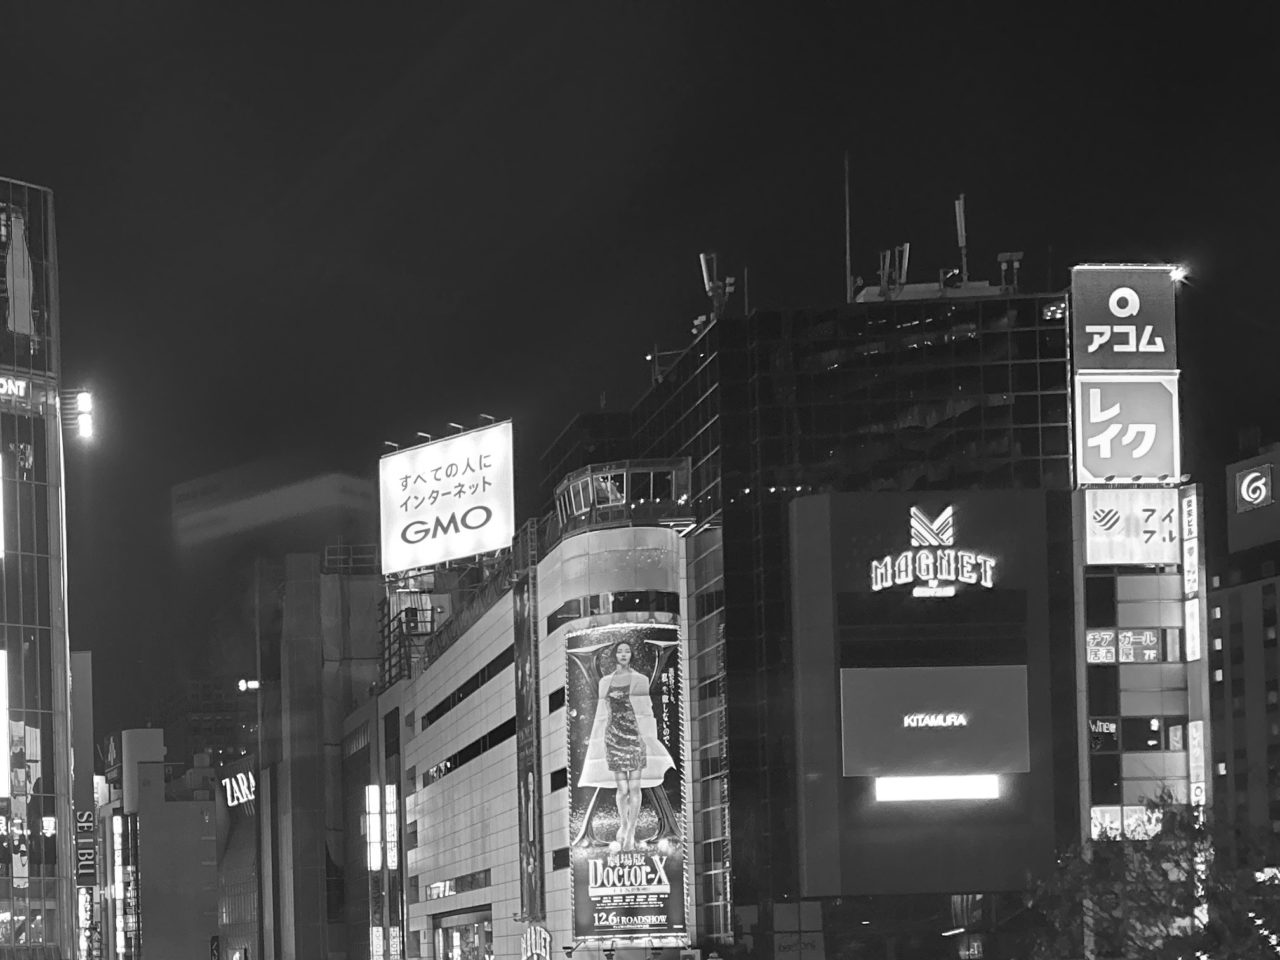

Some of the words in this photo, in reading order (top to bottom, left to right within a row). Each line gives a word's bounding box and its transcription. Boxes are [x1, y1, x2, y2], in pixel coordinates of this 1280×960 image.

[1085, 325, 1165, 353] アコム
[399, 476, 492, 512] インターネット
[401, 505, 492, 544] GMO
[872, 549, 995, 591] MAGNET
[1144, 650, 1156, 660] 7F
[904, 713, 968, 728] KITAMURA
[222, 770, 256, 806] ZARA
[76, 811, 95, 874] SEIBU
[588, 855, 670, 888] Doctor-X
